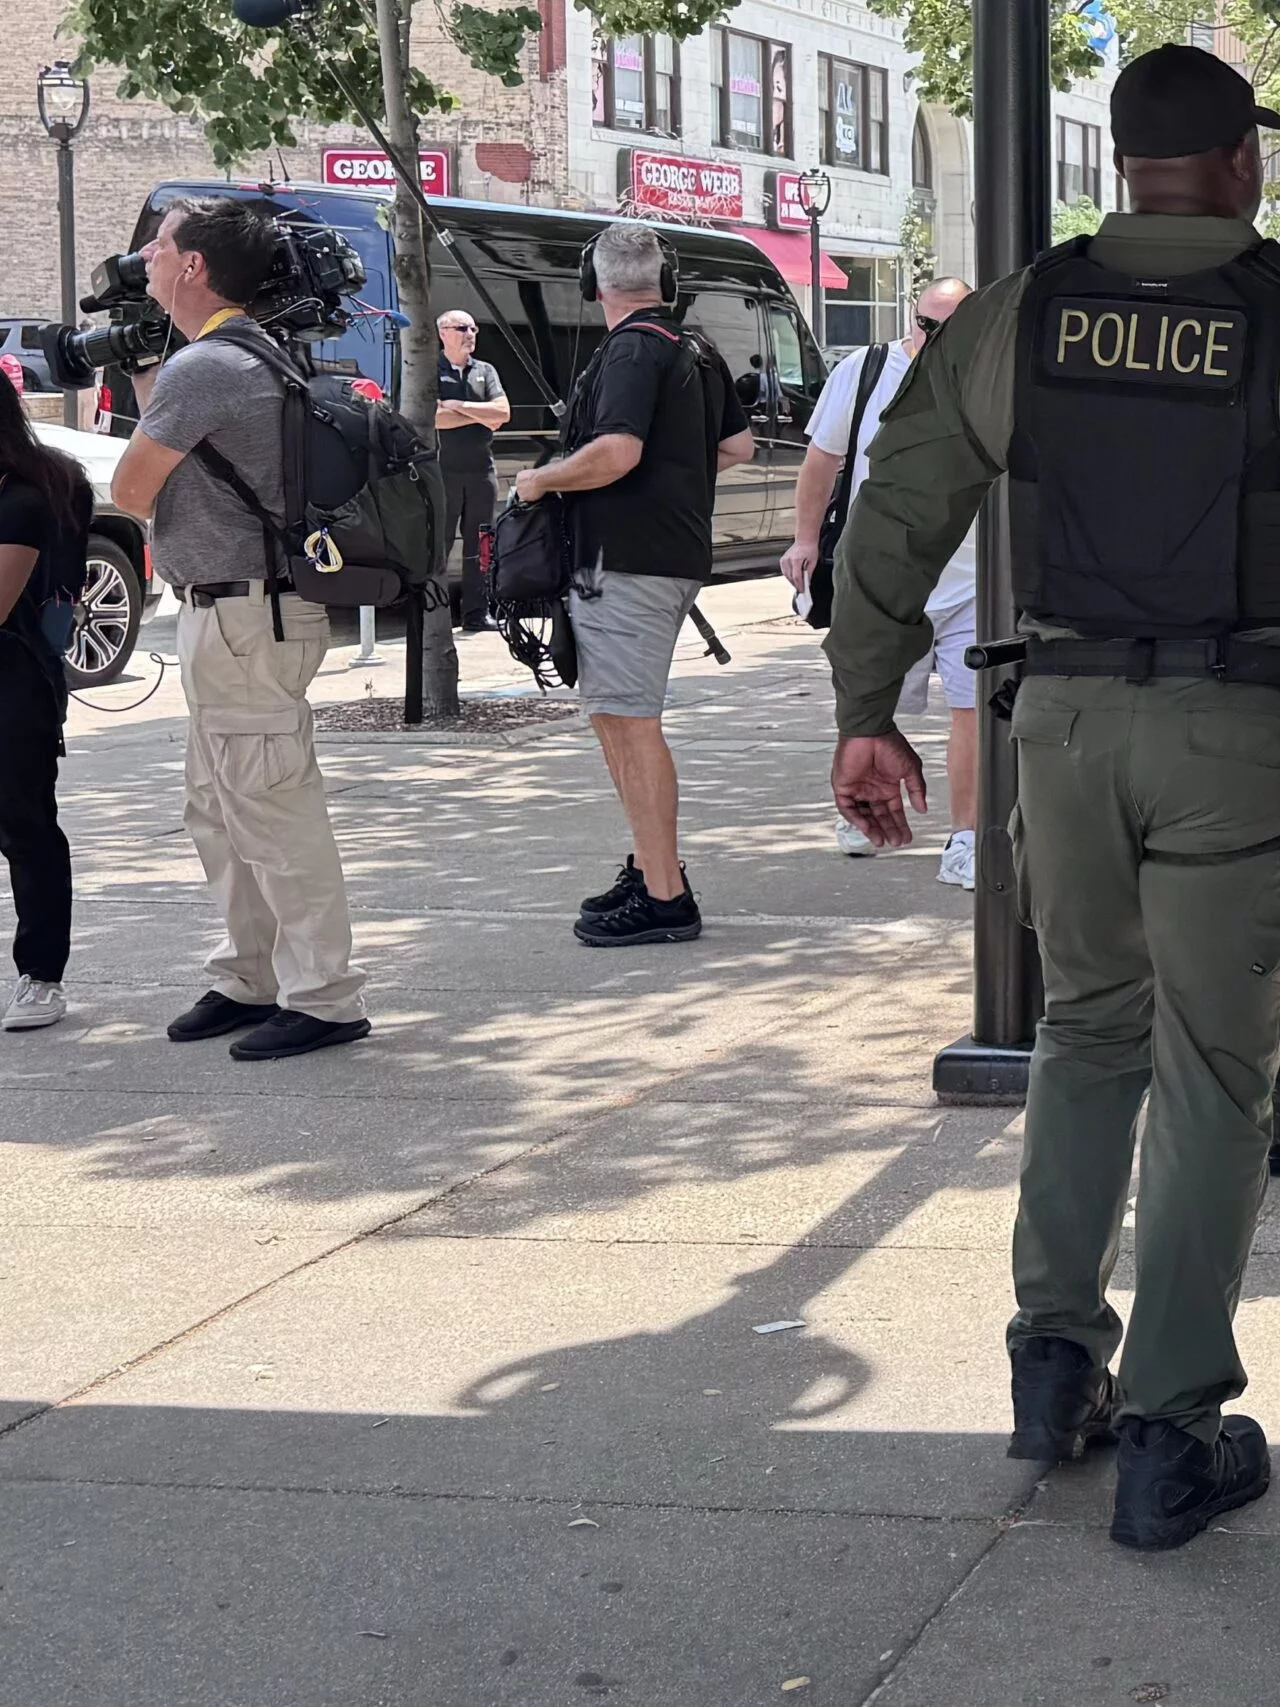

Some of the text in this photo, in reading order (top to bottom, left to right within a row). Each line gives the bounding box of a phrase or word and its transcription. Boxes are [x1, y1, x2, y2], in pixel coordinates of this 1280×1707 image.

[333, 159, 437, 181] GEORE
[641, 162, 740, 194] GEORGE WEBB
[1057, 308, 1233, 377] POLICE
